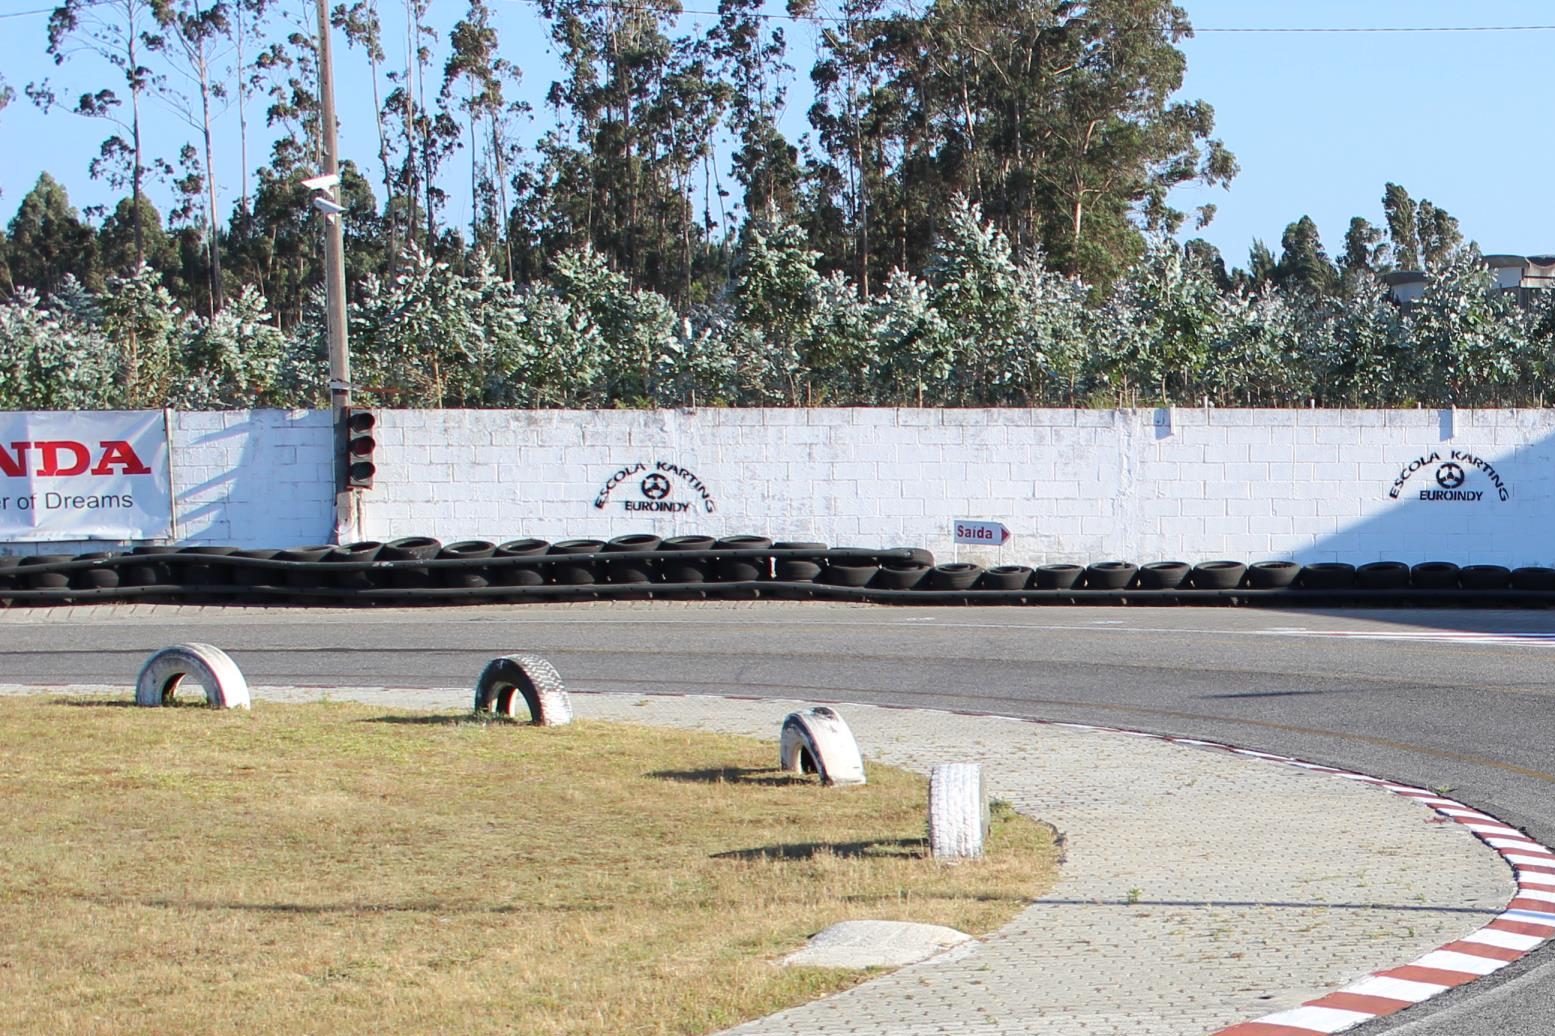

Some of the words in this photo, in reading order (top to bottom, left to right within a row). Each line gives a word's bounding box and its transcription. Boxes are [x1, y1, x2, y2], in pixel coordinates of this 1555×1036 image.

[0, 441, 151, 477] NDA
[594, 463, 647, 509] ESCOLA
[656, 461, 717, 513] KARTING
[1389, 452, 1441, 499] ESCOLA
[1451, 450, 1510, 502] KARTING
[17, 494, 37, 510] of
[45, 492, 133, 510] Dreams
[625, 500, 691, 513] EUROINDY
[1420, 490, 1484, 501] EUROINDY
